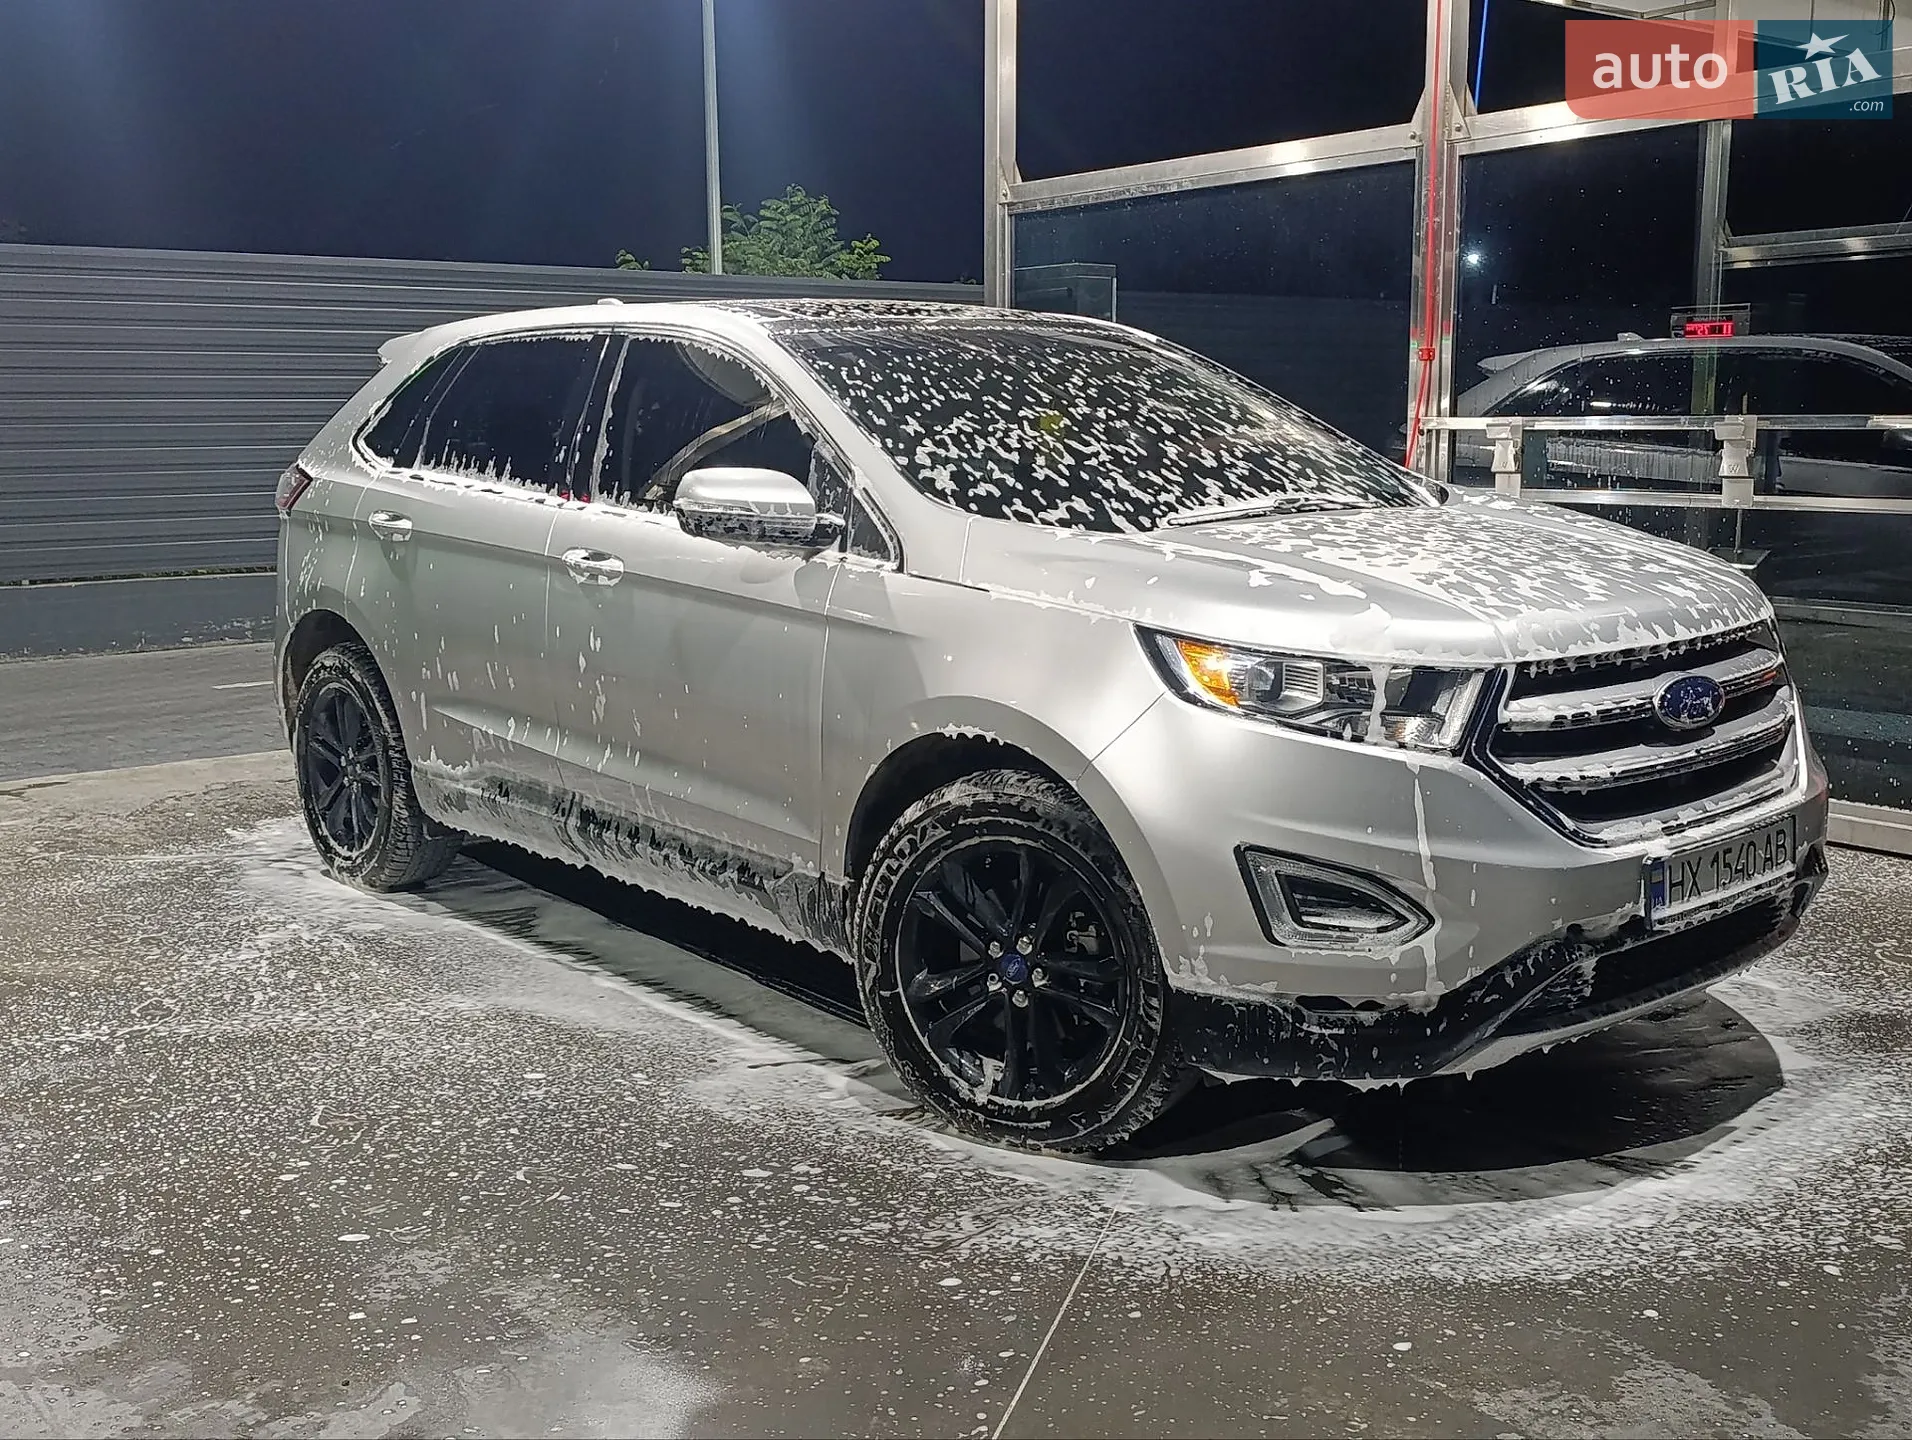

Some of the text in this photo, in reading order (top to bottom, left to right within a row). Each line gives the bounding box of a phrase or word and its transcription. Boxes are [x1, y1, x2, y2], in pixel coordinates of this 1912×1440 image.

[1669, 857, 1702, 906] HX
[1710, 840, 1757, 892] 1540
[1762, 828, 1787, 874] AB
